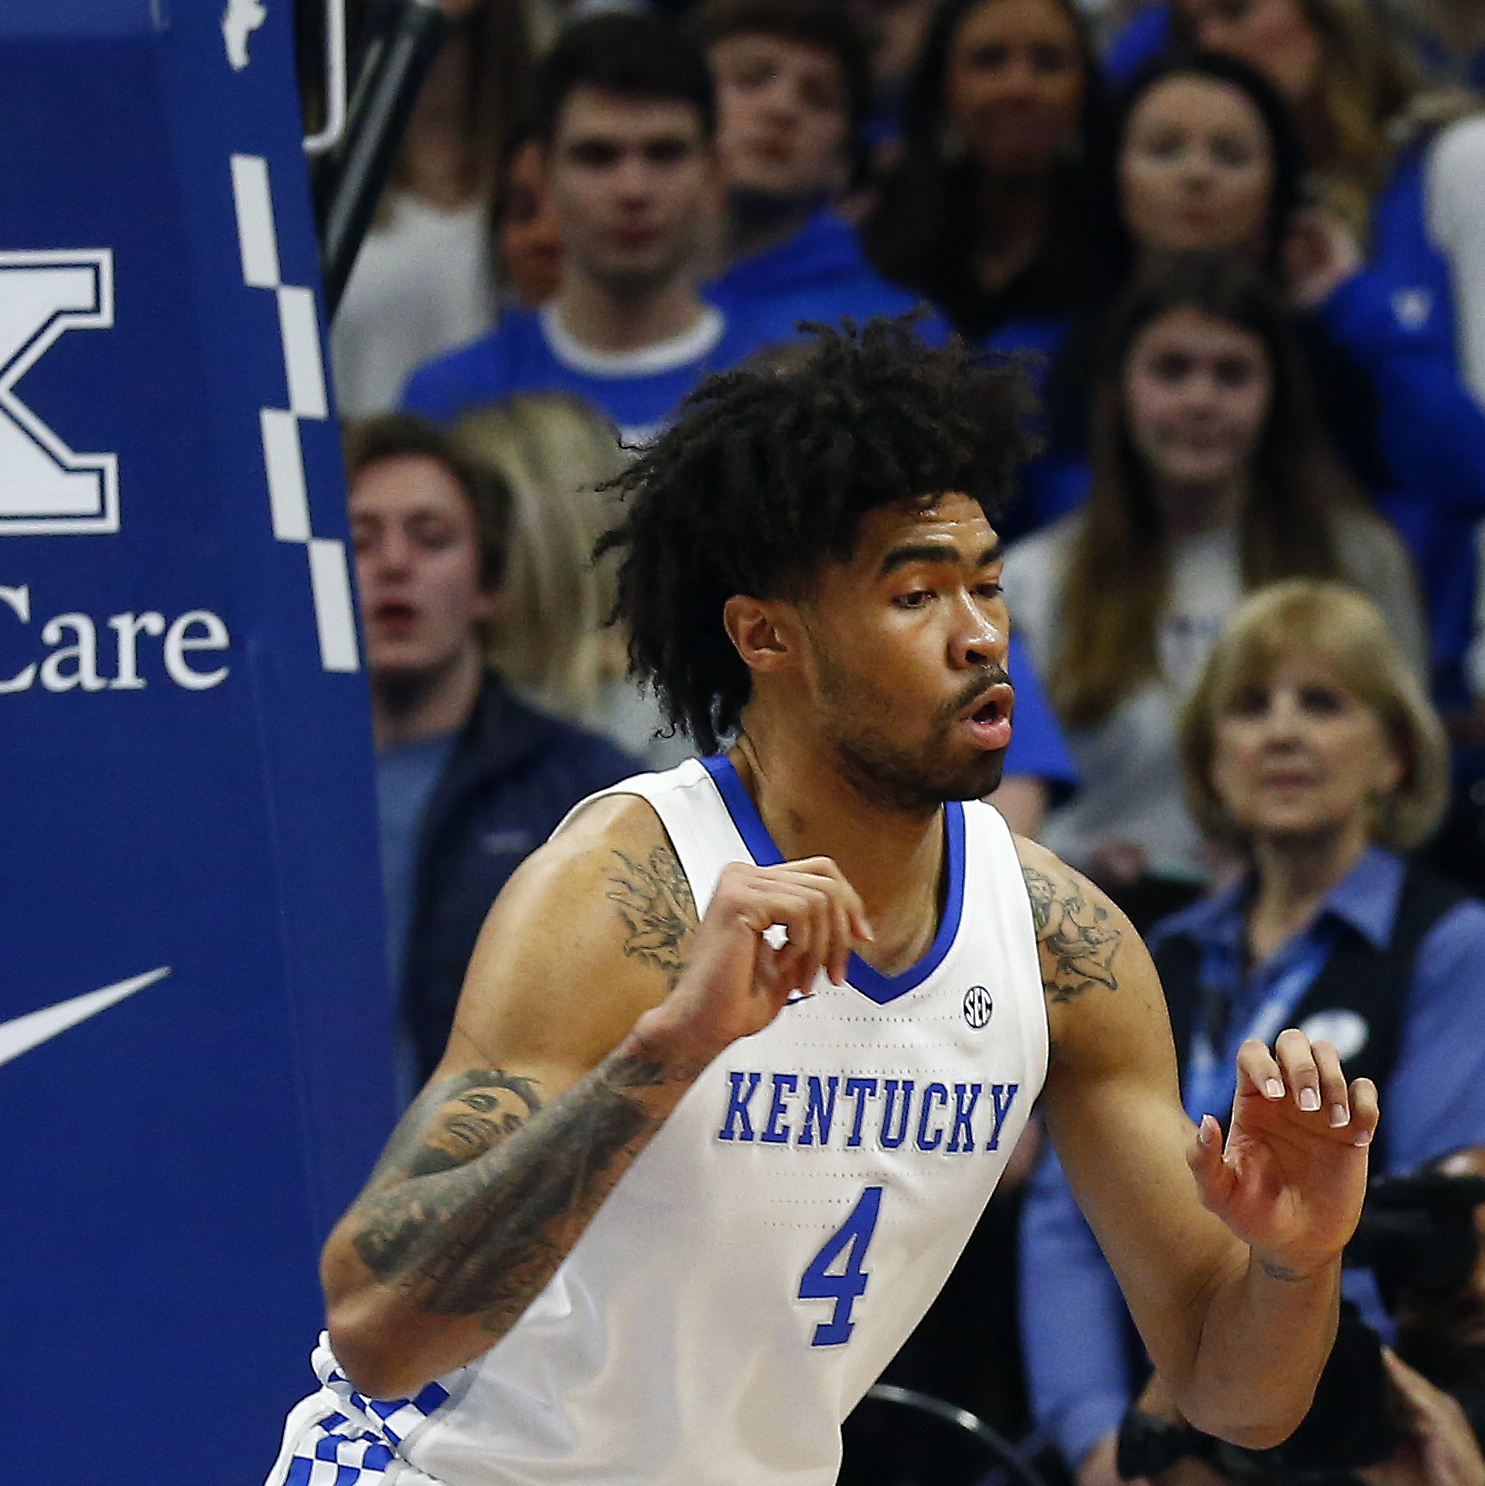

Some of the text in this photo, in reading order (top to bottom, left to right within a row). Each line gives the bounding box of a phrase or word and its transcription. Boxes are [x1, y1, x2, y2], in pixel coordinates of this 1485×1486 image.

[963, 986, 993, 1028] SEC
[718, 1070, 1019, 1153] KENTUCKY
[797, 1185, 883, 1348] 4
